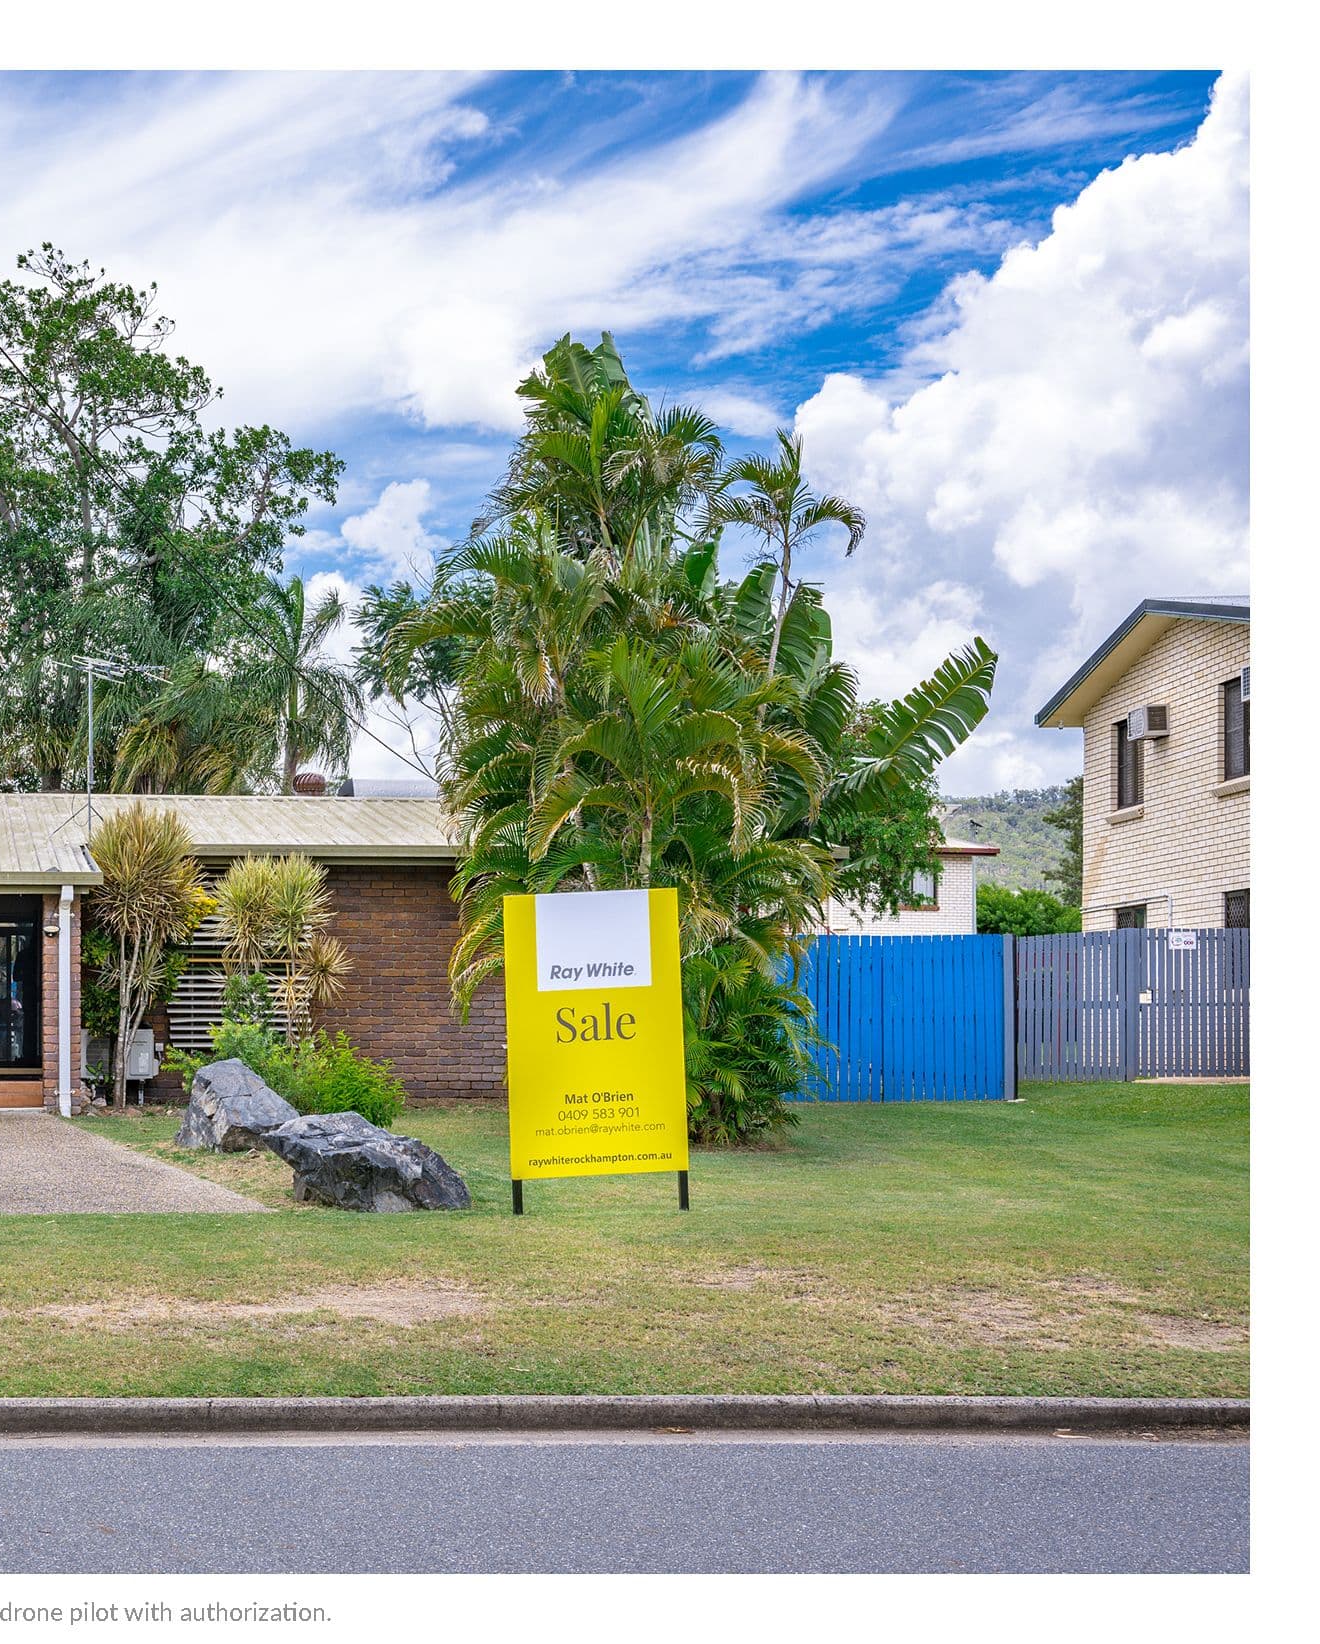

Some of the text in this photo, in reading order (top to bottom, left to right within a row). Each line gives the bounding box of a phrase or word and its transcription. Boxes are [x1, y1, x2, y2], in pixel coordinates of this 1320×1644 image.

[550, 961, 635, 982] Ray White
[556, 1002, 637, 1044] Sale
[564, 1091, 634, 1105] Mat O'Brien
[558, 1106, 640, 1121] 0409 583 901
[535, 1122, 666, 1136] mat.obrien@raywhite.com
[528, 1152, 672, 1167] raywhiterockhampton.com.au
